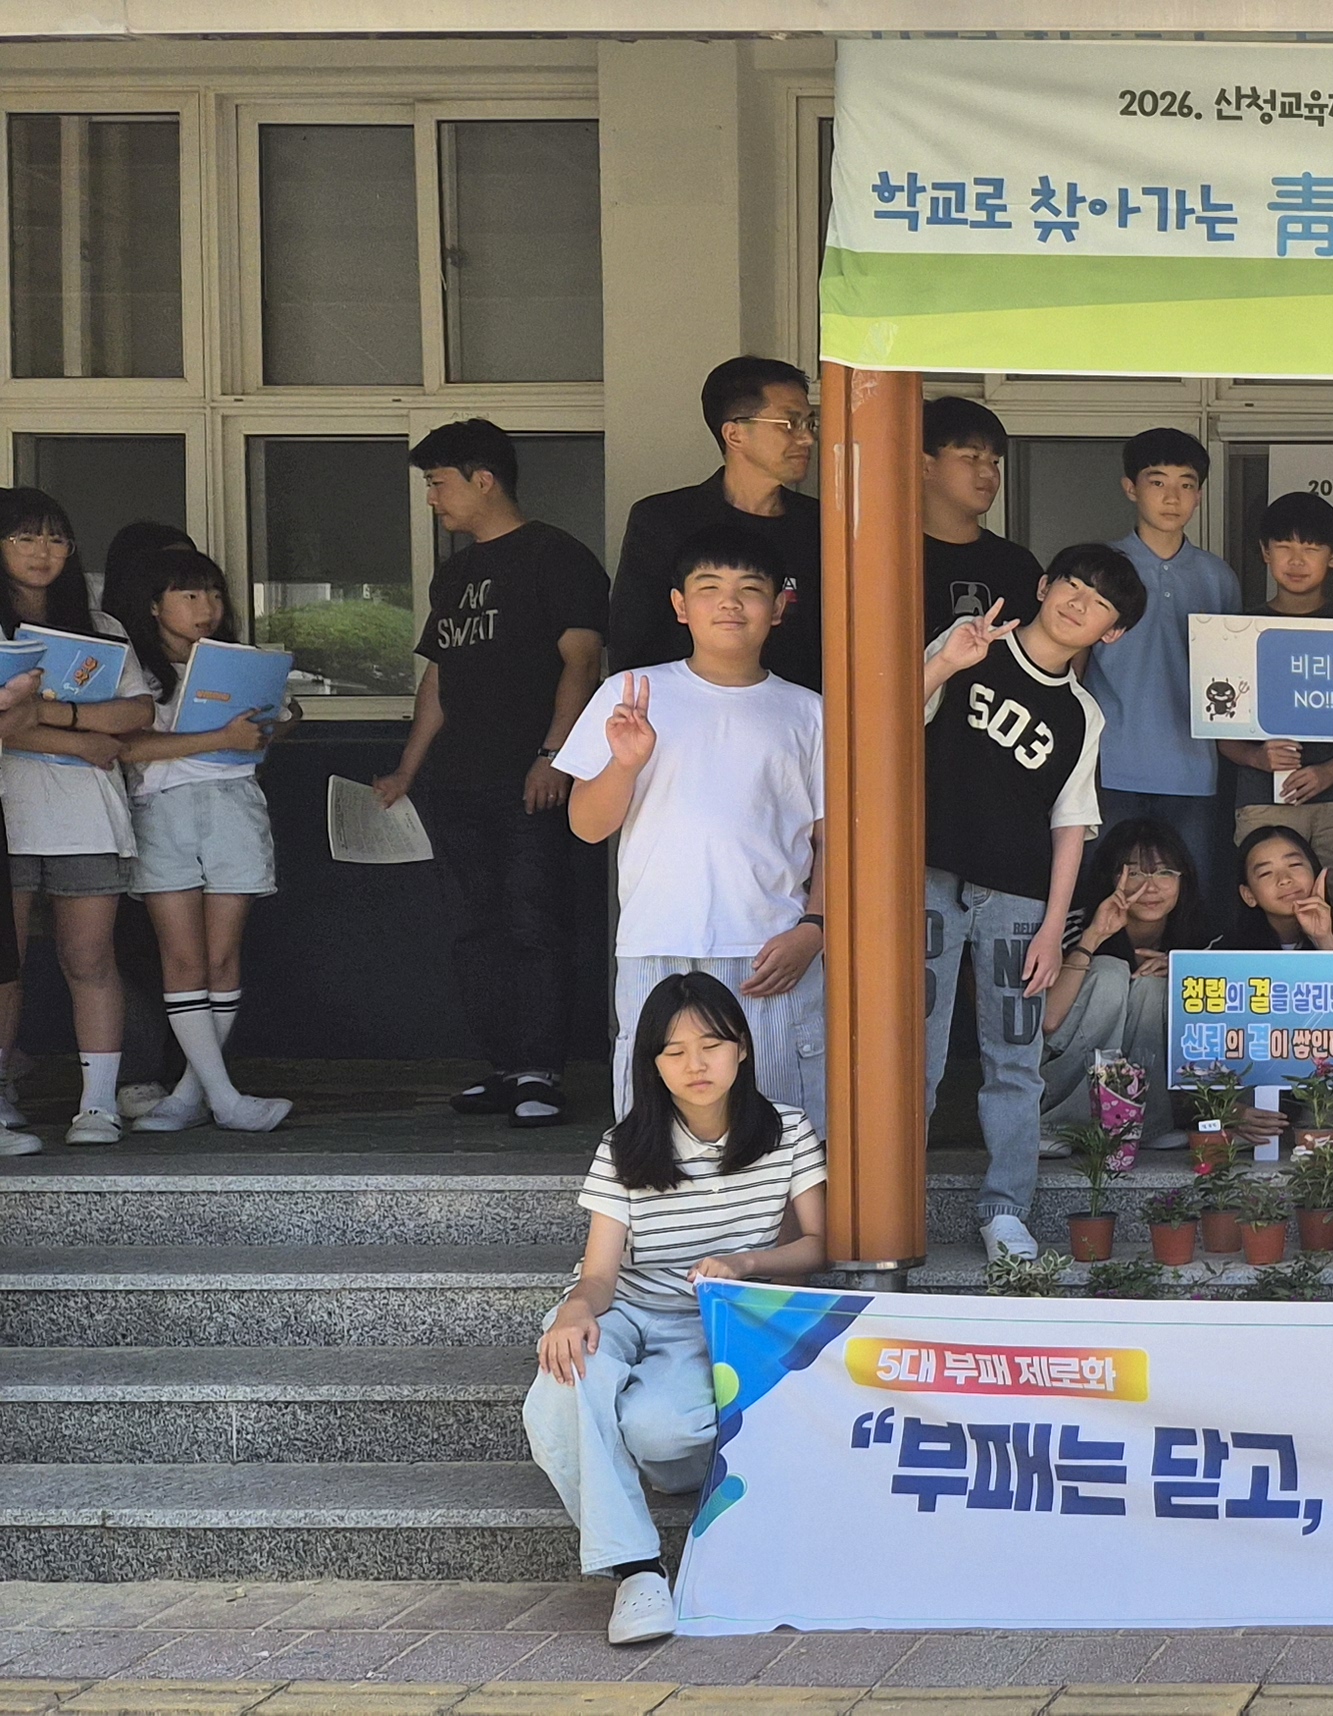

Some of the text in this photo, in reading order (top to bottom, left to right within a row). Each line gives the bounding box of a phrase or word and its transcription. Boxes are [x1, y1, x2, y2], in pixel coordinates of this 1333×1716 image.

[1119, 90, 1203, 120] 2026.
[872, 171, 1012, 234] 학교로
[1030, 174, 1239, 243] 찾아가는
[1291, 653, 1331, 681] 비리
[1181, 976, 1245, 1015] 청렴의
[1248, 977, 1290, 1015] 결을
[1180, 1022, 1245, 1061] 신뢰의
[1247, 1022, 1290, 1061] 결이
[876, 1347, 1117, 1393] 5대 부패 제로화
[1150, 1426, 1323, 1536] 닫고,
